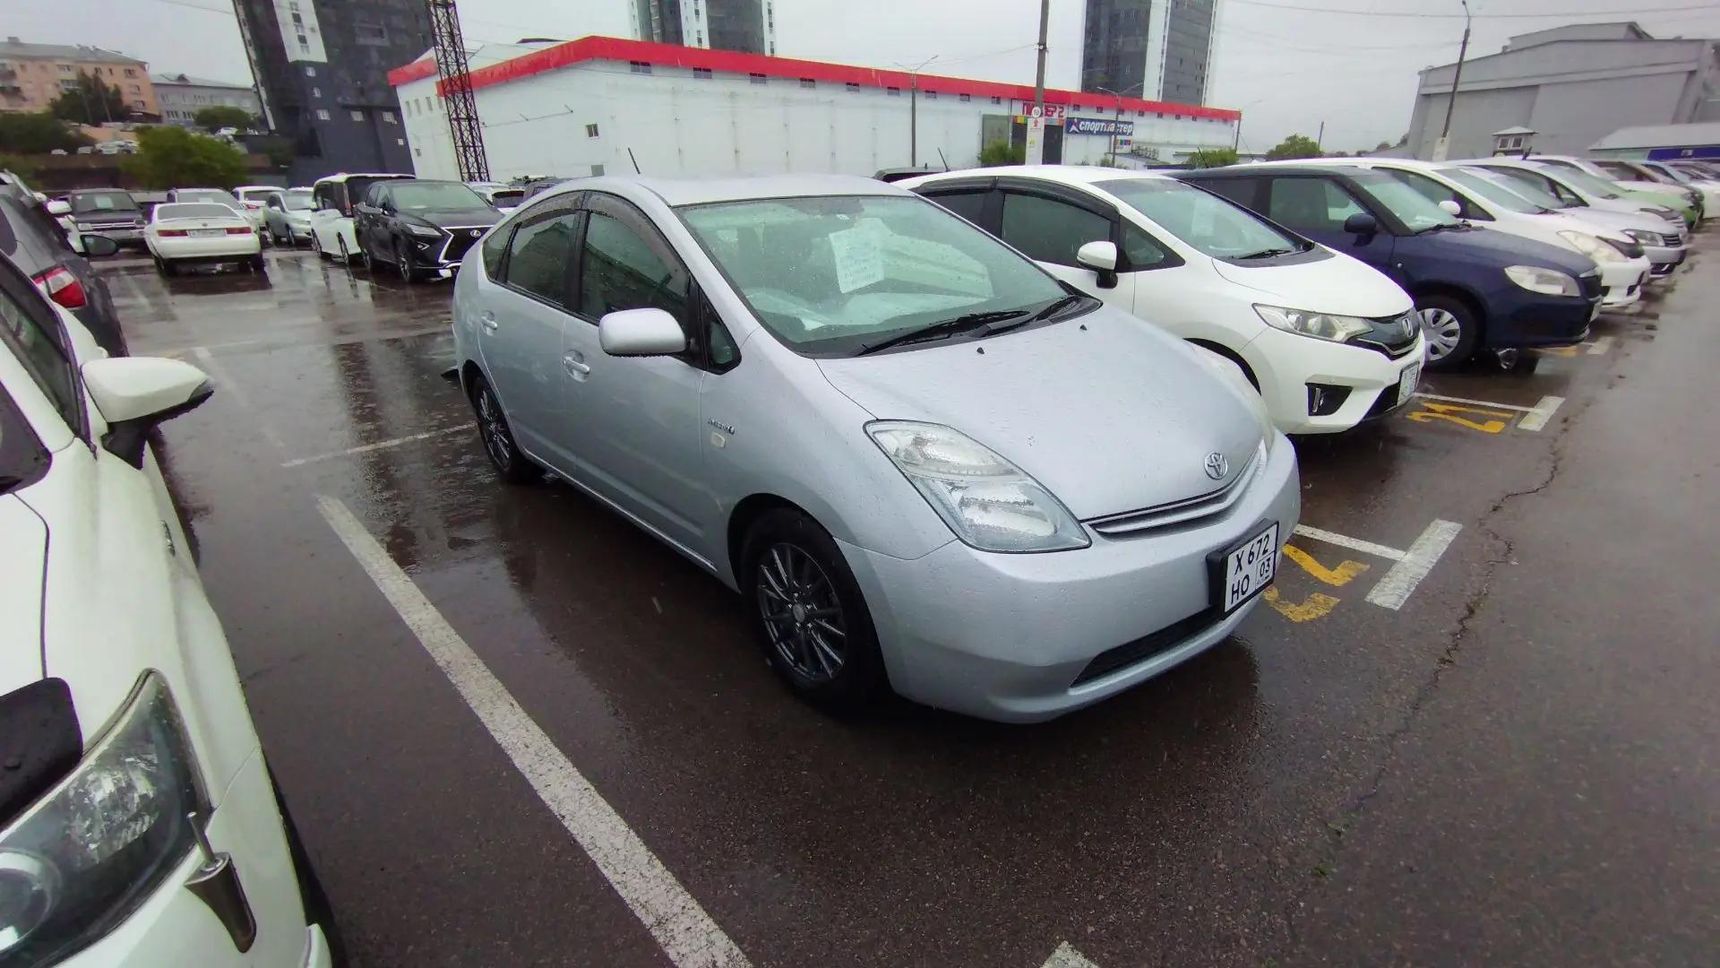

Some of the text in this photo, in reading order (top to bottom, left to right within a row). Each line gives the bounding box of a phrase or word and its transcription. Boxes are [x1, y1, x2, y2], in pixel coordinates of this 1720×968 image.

[1247, 534, 1270, 564] 672
[1231, 557, 1271, 604] НО 03
